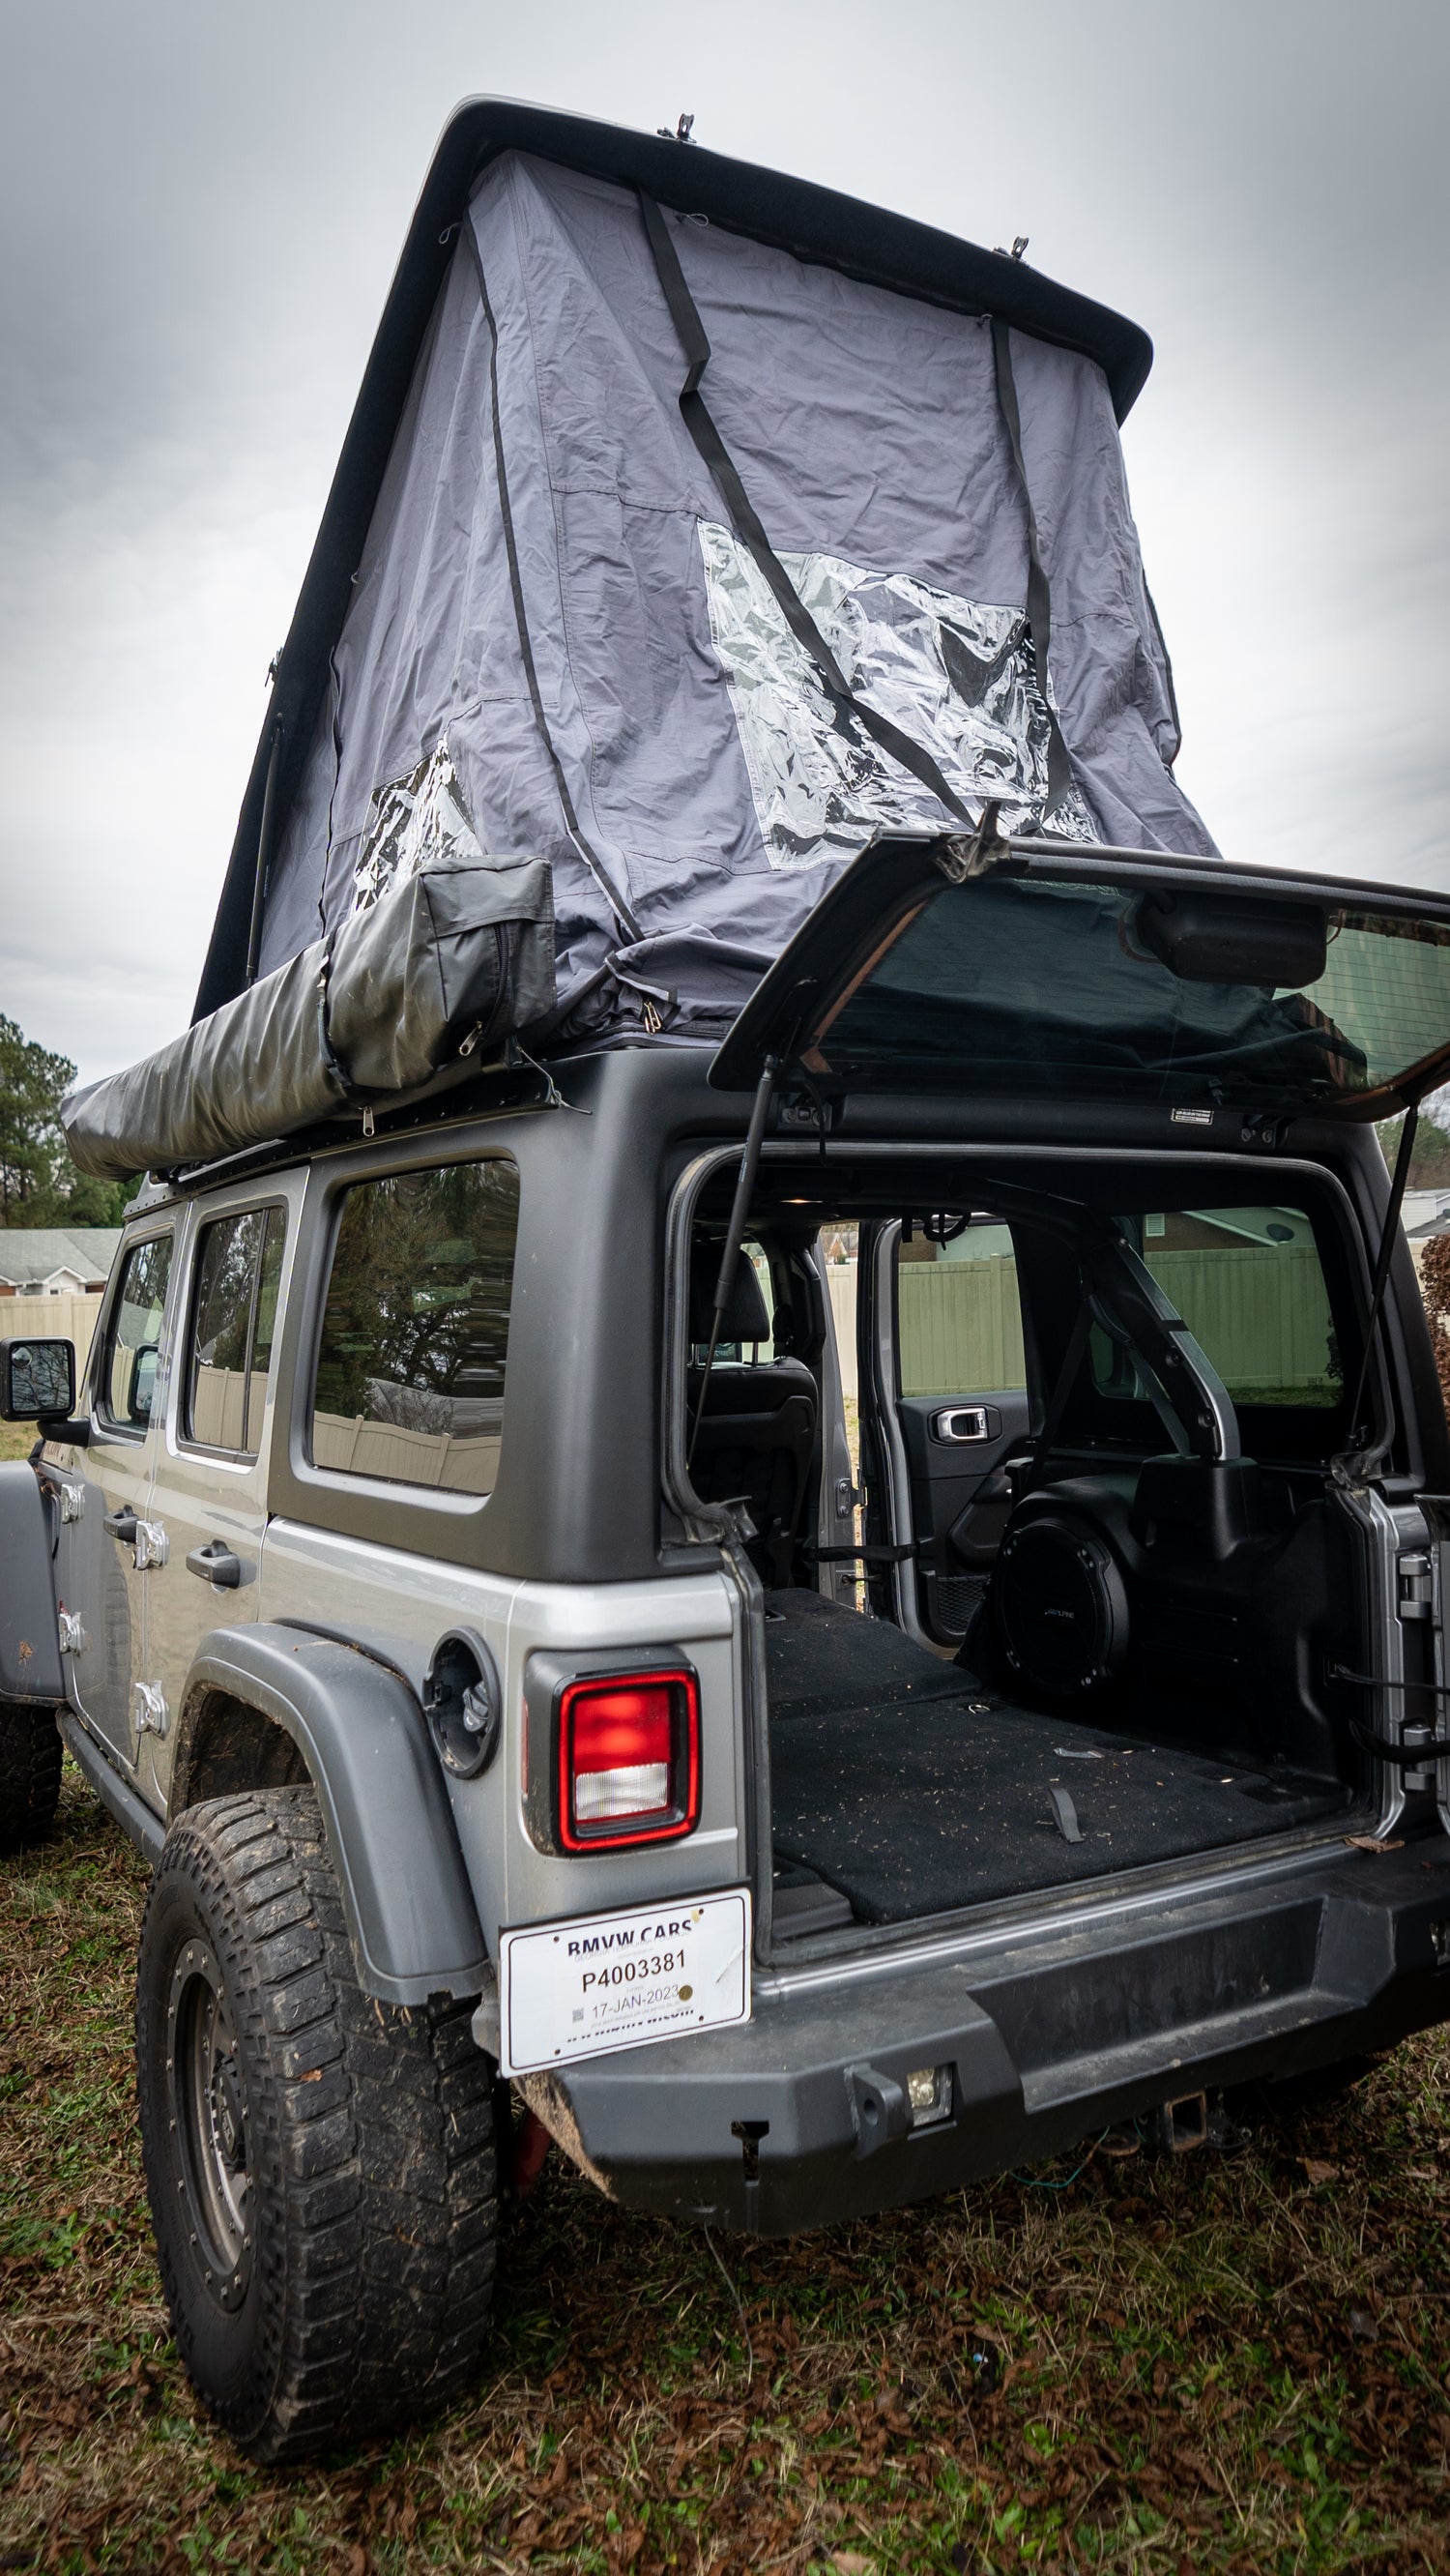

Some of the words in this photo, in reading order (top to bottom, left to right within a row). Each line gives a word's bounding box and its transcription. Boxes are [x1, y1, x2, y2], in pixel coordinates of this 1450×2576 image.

[640, 1919, 692, 1942] CARS
[582, 1949, 685, 1993] P4003381
[592, 1984, 680, 2019] 17-JAN-2023
